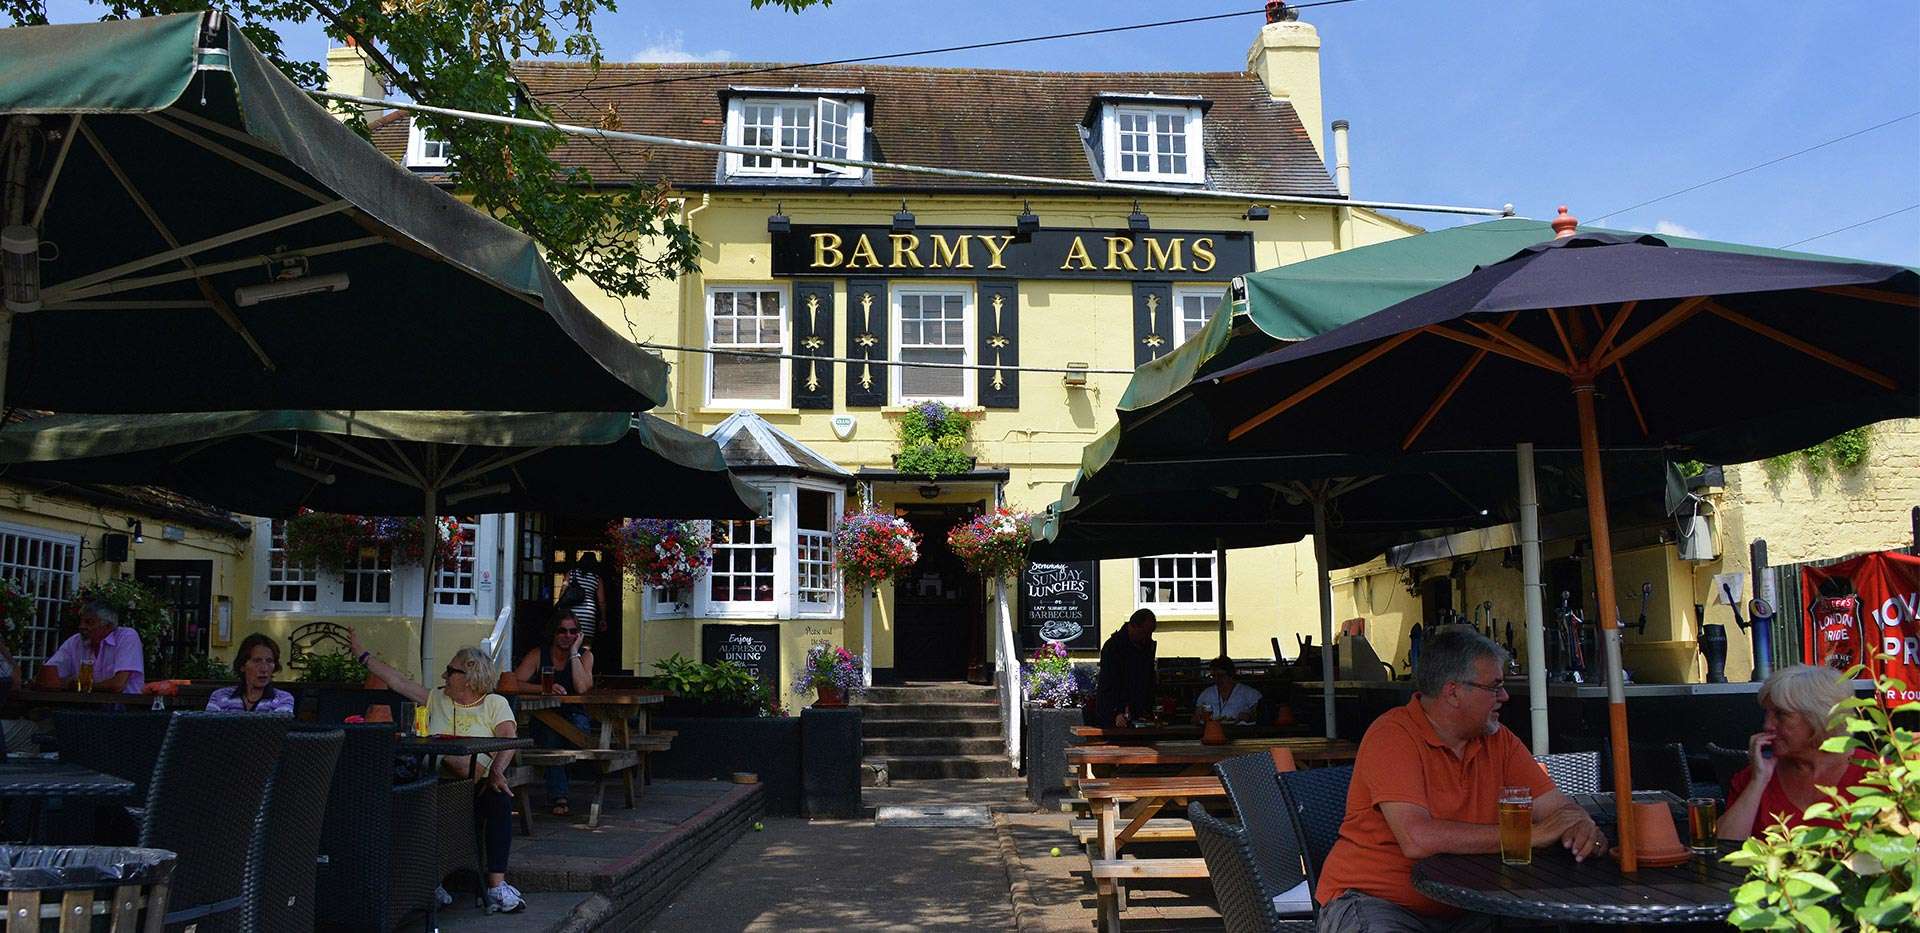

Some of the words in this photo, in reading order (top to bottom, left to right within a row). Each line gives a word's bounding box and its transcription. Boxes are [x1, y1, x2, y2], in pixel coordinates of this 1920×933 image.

[810, 232, 1016, 270] BARMY
[1060, 235, 1219, 273] ARMS
[1031, 570, 1083, 586] SUNDAY
[1028, 580, 1086, 598] LUNCHES
[1029, 611, 1083, 619] BARBECUES
[1818, 612, 1853, 630] LONDON
[728, 633, 755, 645] Enjoy
[725, 652, 762, 661] DINING
